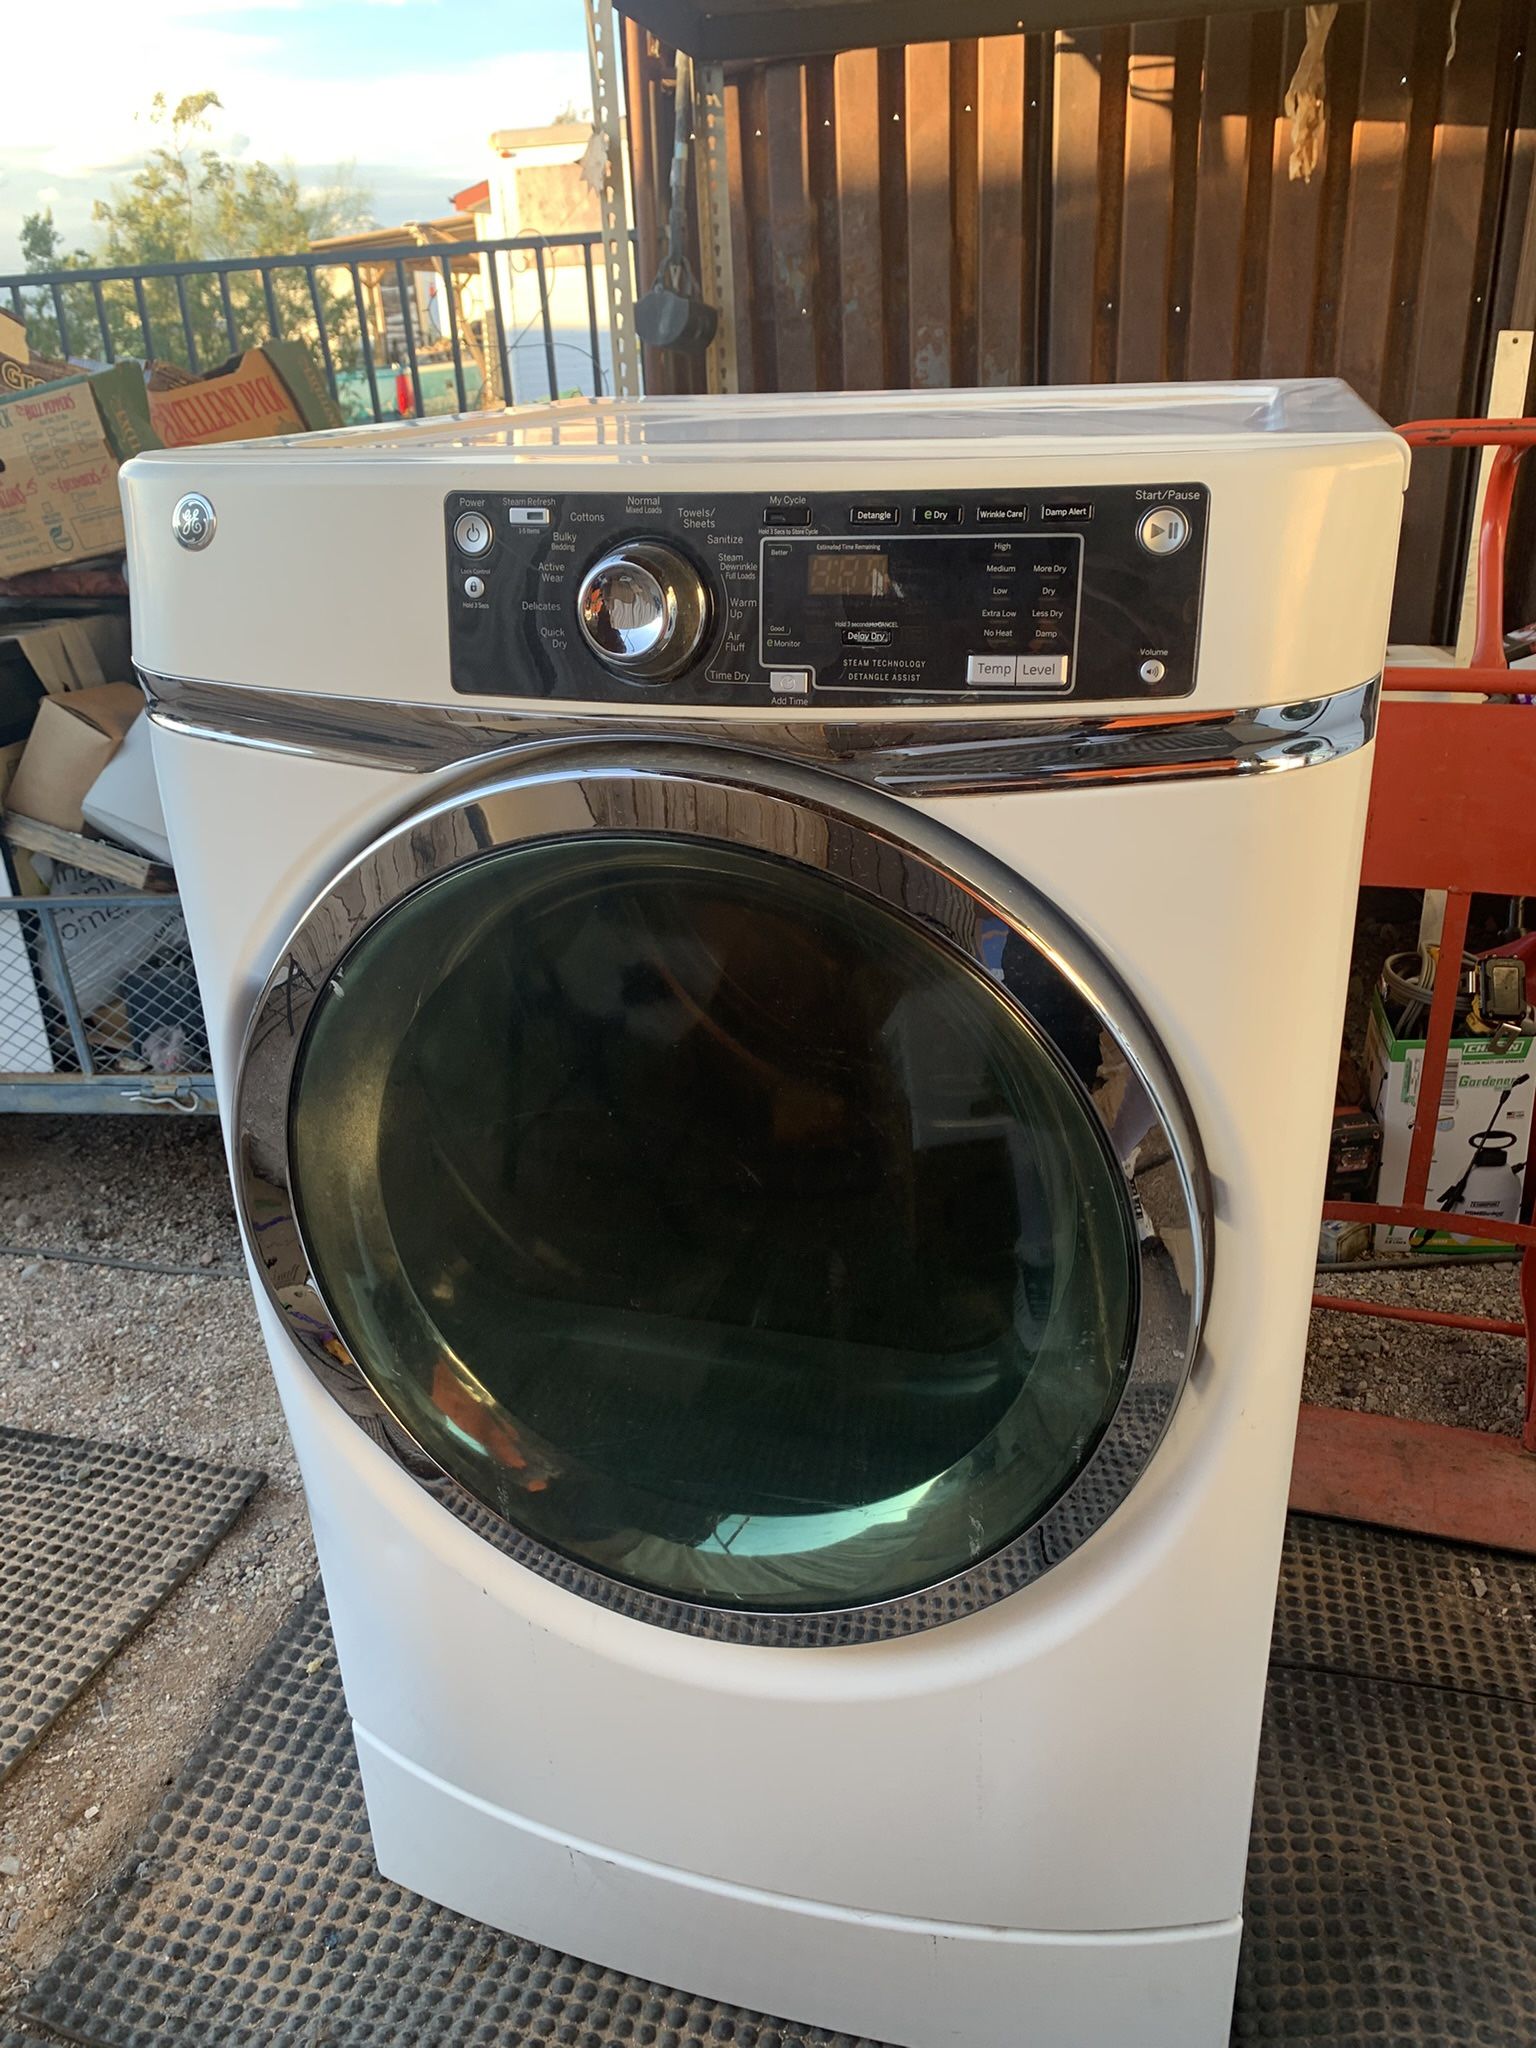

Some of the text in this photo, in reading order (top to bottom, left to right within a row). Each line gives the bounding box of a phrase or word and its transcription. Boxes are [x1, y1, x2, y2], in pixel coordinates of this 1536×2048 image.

[153, 386, 251, 441] EXCELLENT
[237, 376, 288, 418] PICK
[1135, 490, 1201, 500] Start/Pause
[460, 498, 485, 507] Power
[502, 497, 556, 506] Steam Refresh
[627, 496, 660, 505] Normal
[769, 496, 807, 506] My Cycle
[626, 506, 662, 514] Mixed Loads
[678, 507, 716, 518] Towels/
[980, 509, 1023, 518] Wrinkle Care
[1045, 507, 1087, 517] Damp Alert
[570, 512, 605, 522] Cottons
[857, 511, 891, 521] Detangle
[933, 511, 948, 522] Dry
[683, 519, 716, 528] Sheets
[553, 532, 577, 543] Bulky
[707, 534, 744, 544] Sanitize
[551, 543, 575, 552] Bedding
[994, 543, 1011, 551] High
[718, 553, 743, 561] Steam
[539, 562, 565, 571] Active
[720, 562, 758, 571] Dewrinkle
[986, 564, 1016, 573] Medium
[1033, 564, 1067, 574] More Dry
[541, 573, 564, 582] Wear
[725, 572, 756, 580] Full Loads
[993, 587, 1008, 595] Low
[1042, 587, 1056, 597] Dry
[522, 601, 561, 611] Delicates
[730, 598, 757, 607] Warm
[730, 610, 743, 620] Up
[982, 609, 1016, 617] Extra Low
[1032, 609, 1064, 619] Less Dry
[540, 627, 565, 638] Quick
[727, 632, 740, 641] Air
[848, 632, 885, 642] Delay Dry
[1035, 629, 1058, 639] Damp
[552, 639, 567, 650] Dry
[725, 643, 745, 652] Fluff
[1140, 648, 1168, 656] Volume
[843, 659, 926, 668] STEAM TECHNOLOGY
[978, 663, 1012, 677] Temp
[1023, 664, 1056, 676] Level
[710, 670, 750, 682] Time Dry
[892, 674, 921, 682] ASSIST
[770, 697, 809, 706] Add Time
[61, 905, 131, 941] ome.
[1468, 1042, 1520, 1052] CHN
